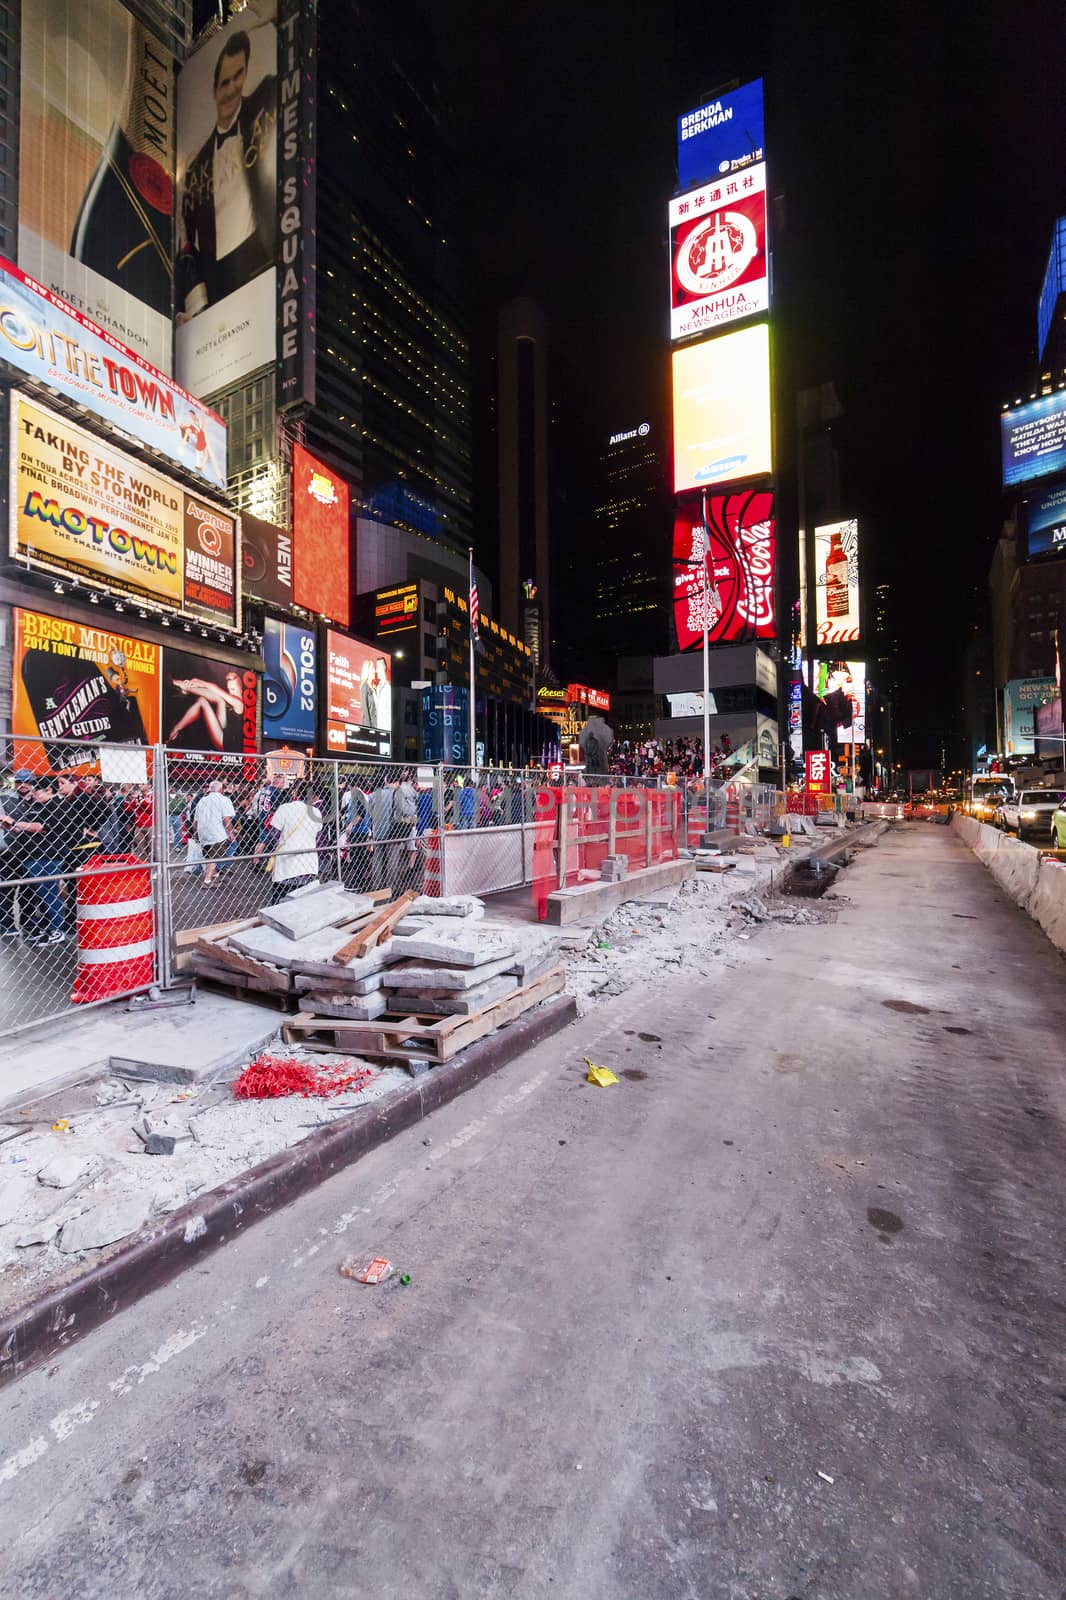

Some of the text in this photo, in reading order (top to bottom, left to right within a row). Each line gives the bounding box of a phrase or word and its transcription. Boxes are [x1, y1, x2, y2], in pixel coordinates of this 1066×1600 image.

[681, 101, 722, 129] BRENDA
[681, 107, 733, 141] BERKMAN
[281, 11, 300, 359] TIMES SQUARE
[677, 175, 755, 216] 新华通讯社
[25, 276, 47, 296] NEW
[82, 318, 102, 335] NEW
[680, 300, 759, 333] NEWS AGENCY
[692, 293, 746, 320] XINHUA
[95, 310, 148, 347] CHANDON
[218, 320, 250, 344] CHANDON
[54, 331, 103, 388] THE
[102, 356, 177, 422] TOWN
[282, 377, 297, 389] NYC
[609, 429, 637, 445] Allianz
[1010, 420, 1065, 443] MATILDA WAS
[1014, 444, 1040, 457] KNOW
[1041, 437, 1062, 448] HOW
[1015, 437, 1036, 448] THEY
[1037, 430, 1056, 442] JUST
[22, 419, 178, 511] TAKING THE WORLD
[21, 452, 33, 462] ON
[35, 457, 57, 475] TOUR
[59, 470, 89, 489] ACROSS
[123, 501, 150, 521] LONDON
[62, 458, 151, 511] BY STORM!
[21, 465, 48, 486] FINAL
[51, 478, 98, 511] BROADWAY
[101, 503, 155, 535] PERFORMANCE
[156, 527, 170, 541] JAN
[186, 501, 232, 535] Avenue
[24, 490, 177, 575] MOTOWN
[198, 522, 222, 556] Q
[53, 529, 156, 575] THE SMASH HITS MUSICAL
[186, 548, 232, 580] WINNER
[277, 534, 292, 587] NEW
[186, 569, 232, 594] BEST MUSICAL
[675, 574, 695, 586] give
[23, 612, 156, 663] BEST MUSICAL!
[23, 635, 155, 675] 2014 TONY AWARD WINNER
[329, 652, 350, 670] Faith
[39, 675, 109, 739] GENTLEMAN'S
[45, 697, 57, 710] A
[71, 716, 111, 736] GUIDE
[243, 671, 257, 782] CHICAGO
[811, 753, 827, 780] tkts
